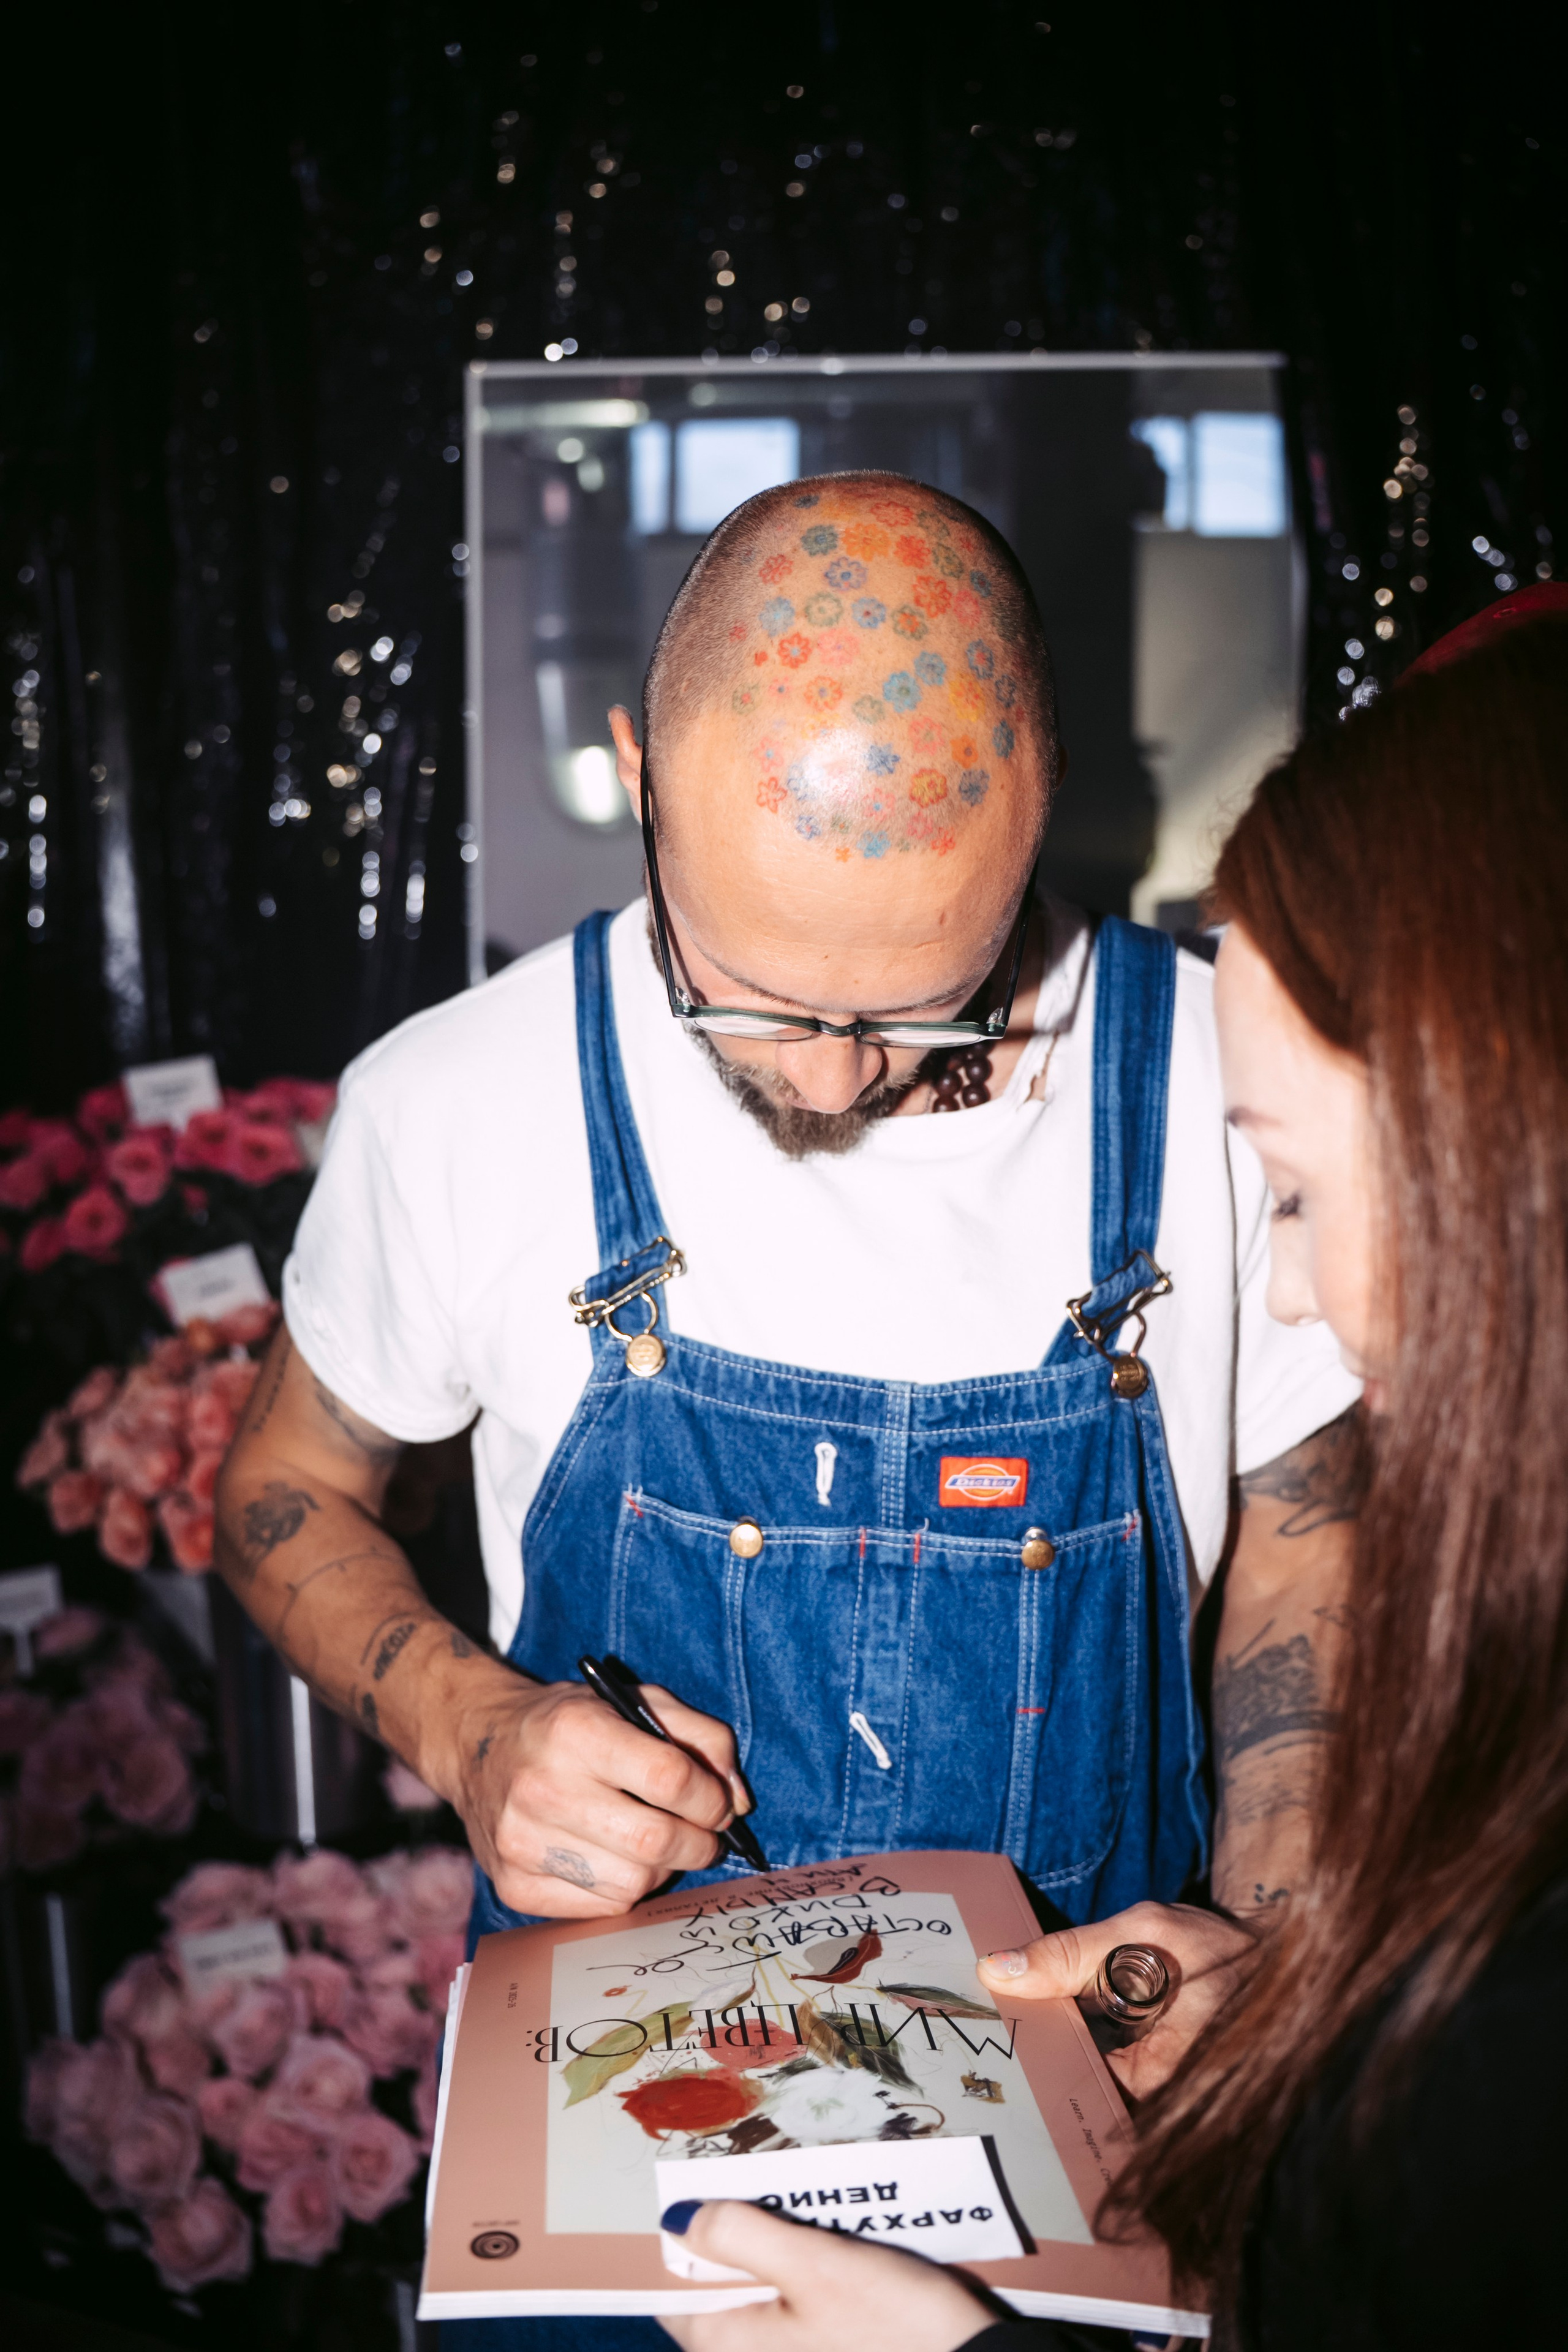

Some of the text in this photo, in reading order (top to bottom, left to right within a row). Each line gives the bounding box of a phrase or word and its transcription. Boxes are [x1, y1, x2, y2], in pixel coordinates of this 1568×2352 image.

[525, 2000, 1023, 2064] МИР ЦВЕТОВ:
[1069, 2098, 1085, 2123] Learn.
[758, 2181, 898, 2211] ДЕНИС
